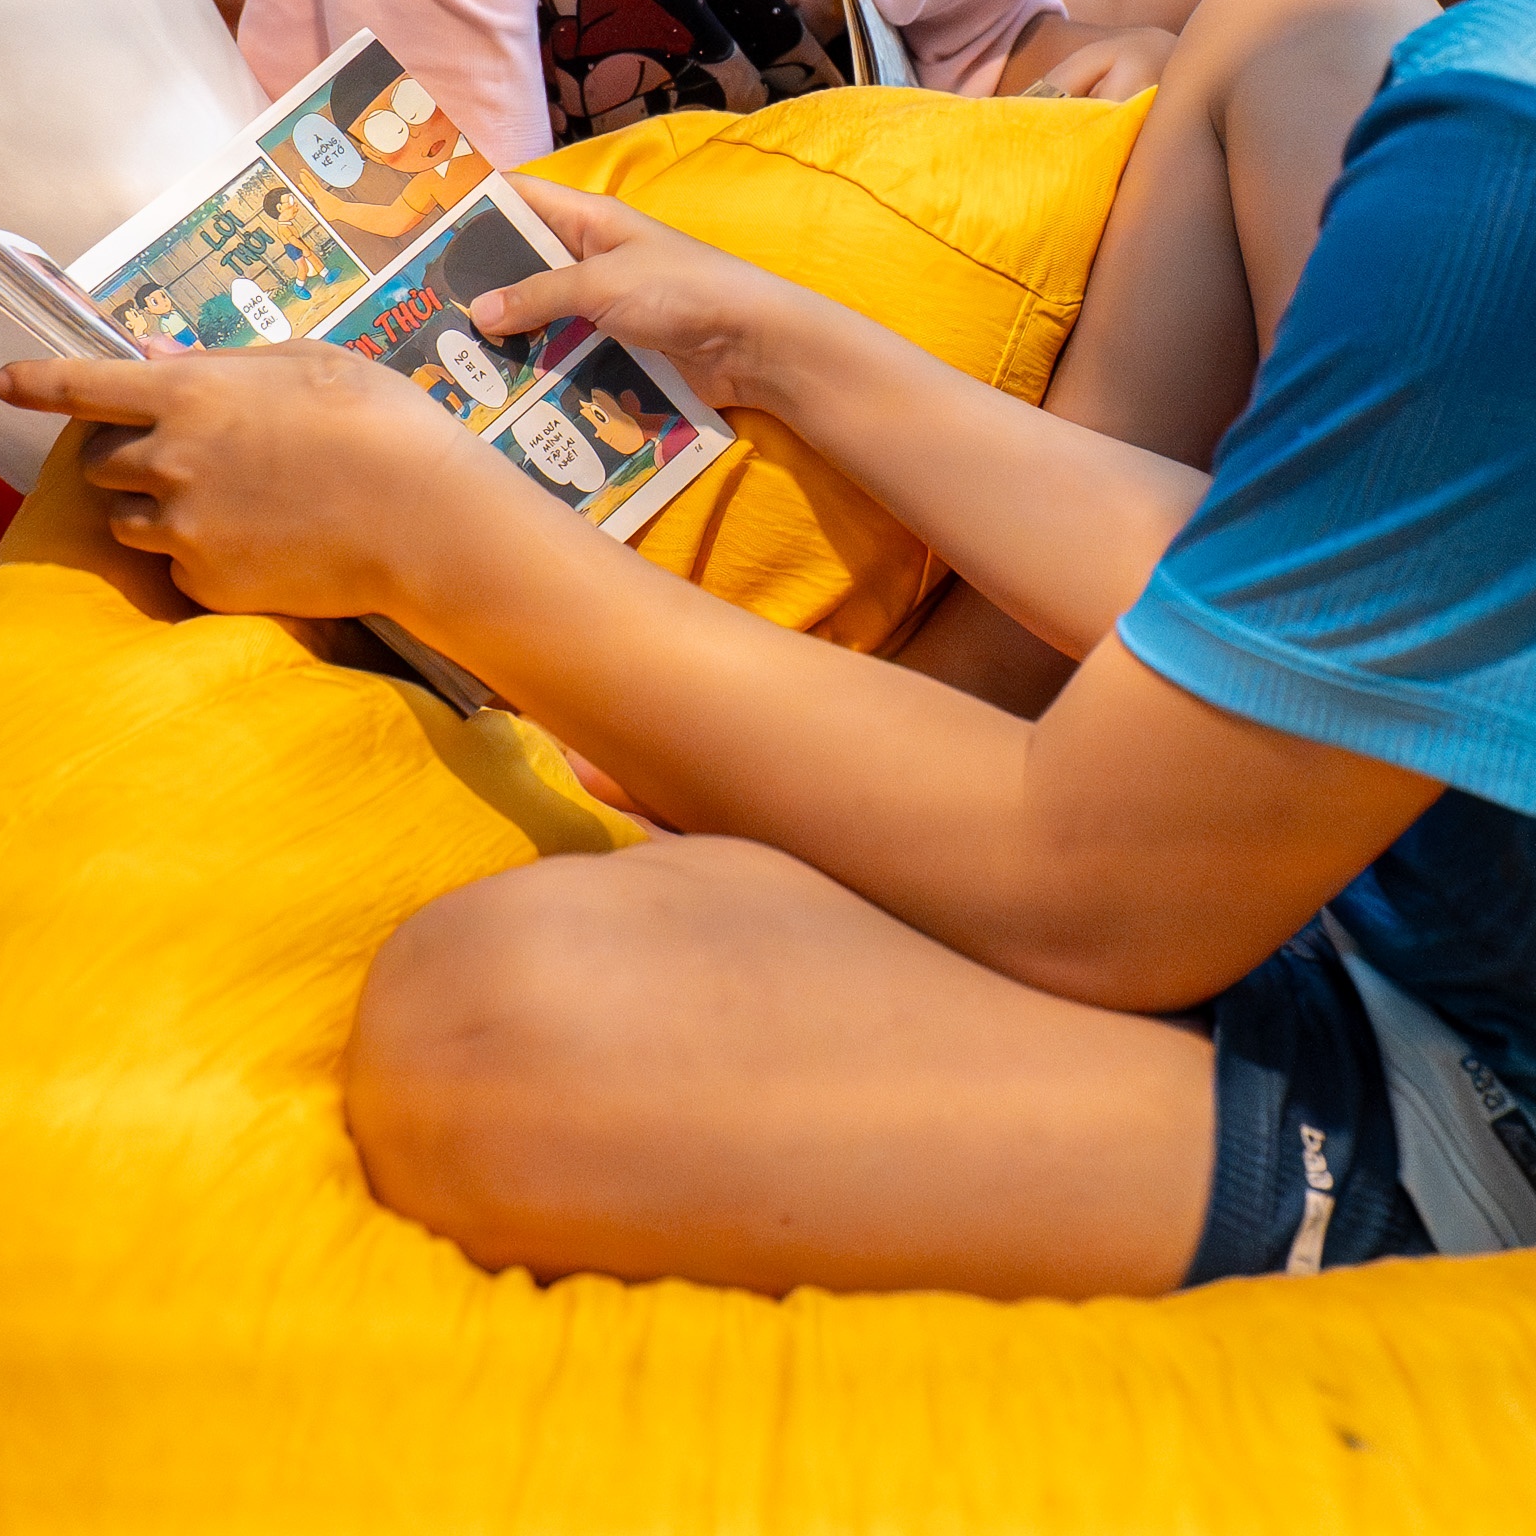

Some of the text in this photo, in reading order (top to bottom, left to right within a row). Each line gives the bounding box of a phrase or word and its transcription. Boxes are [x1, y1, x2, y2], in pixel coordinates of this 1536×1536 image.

[453, 350, 469, 366] NO
[471, 370, 487, 383] TA
[529, 434, 544, 448] HAI
